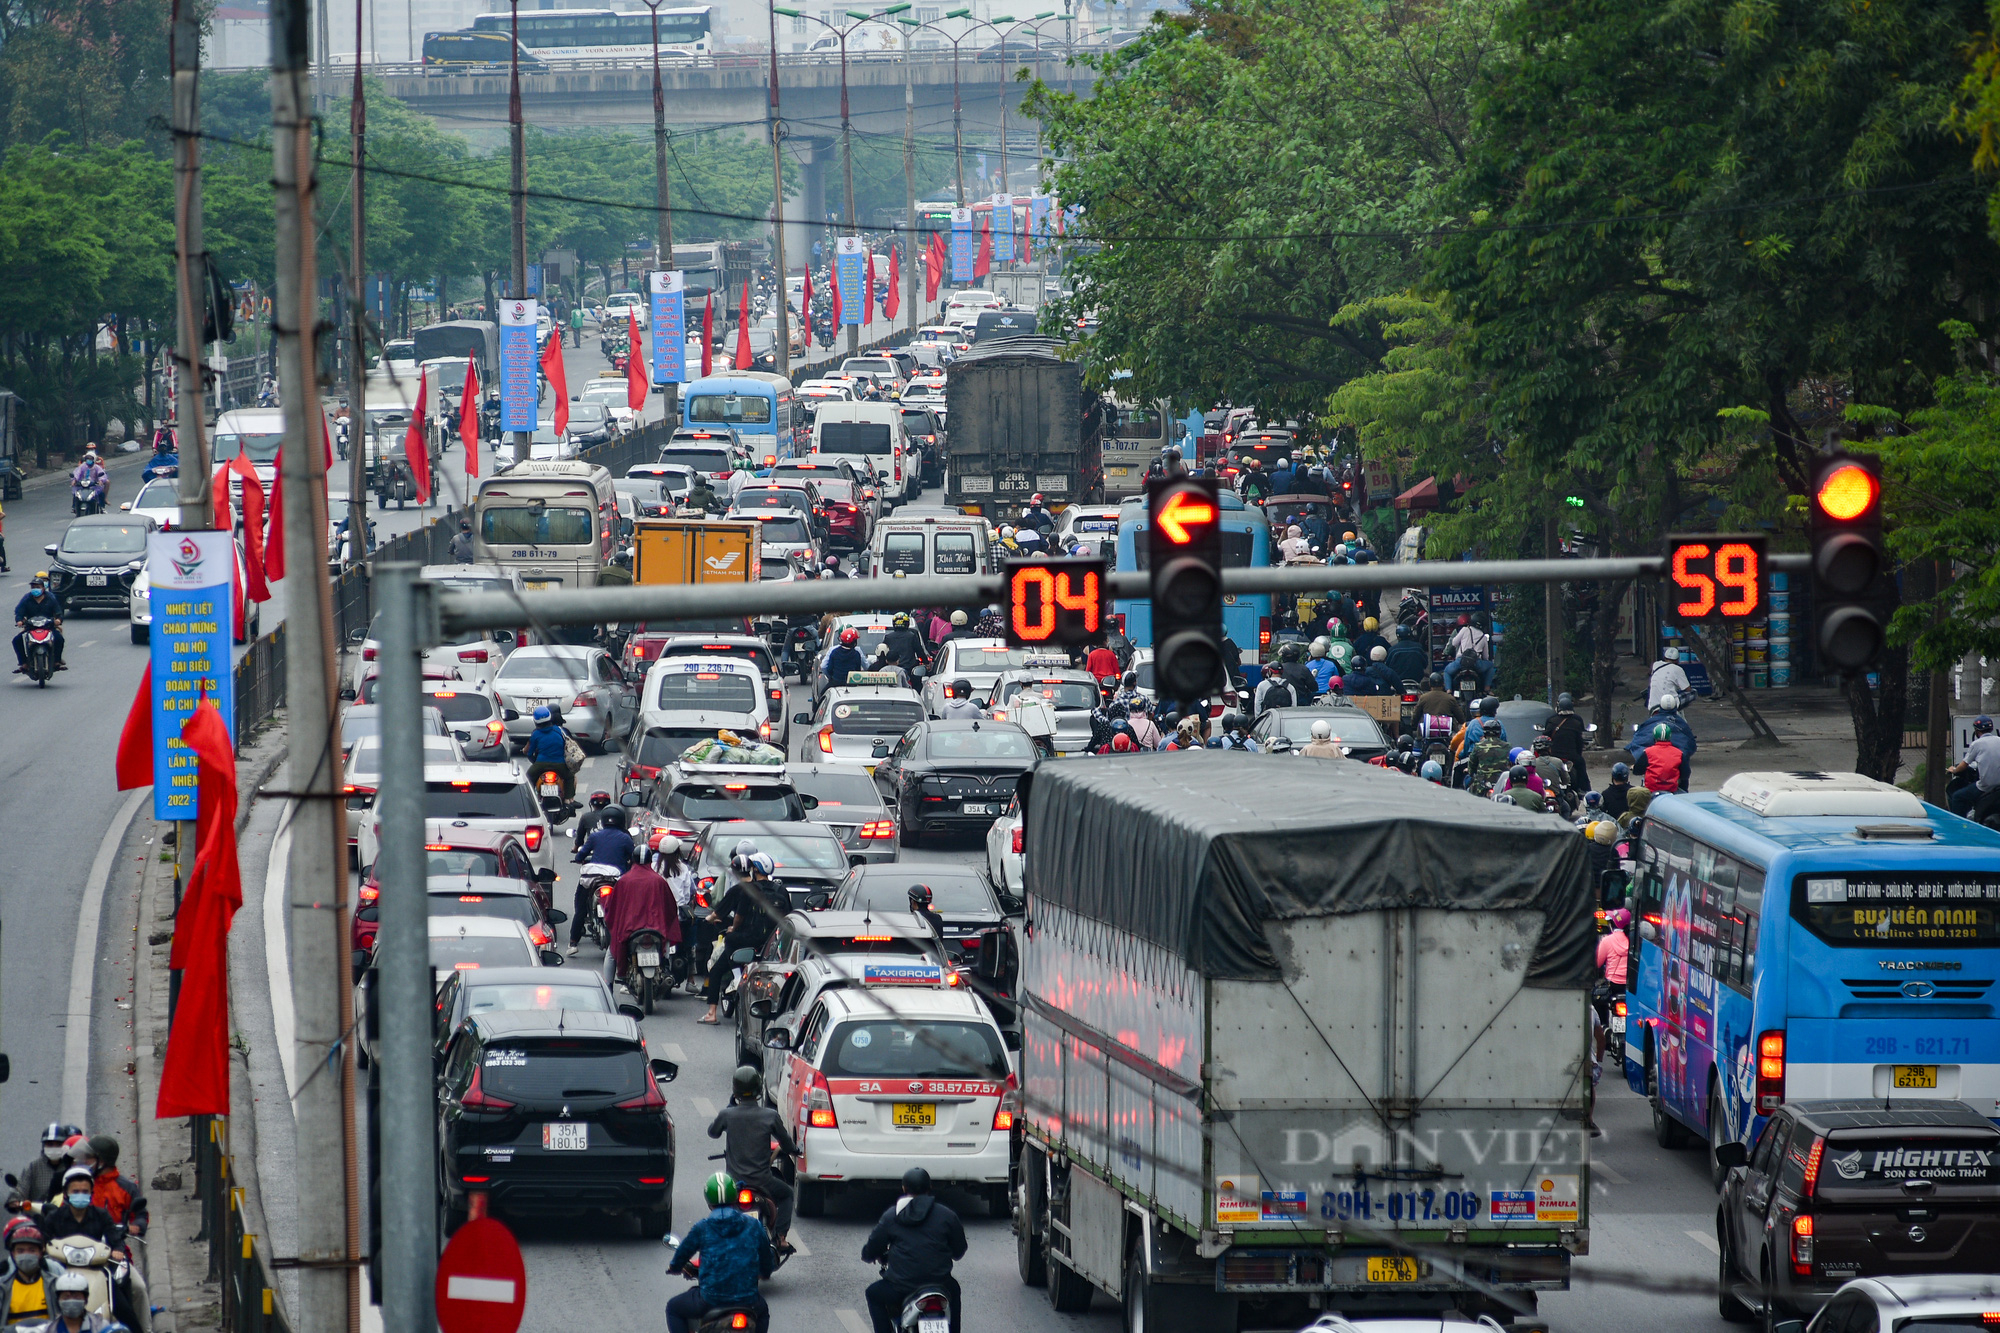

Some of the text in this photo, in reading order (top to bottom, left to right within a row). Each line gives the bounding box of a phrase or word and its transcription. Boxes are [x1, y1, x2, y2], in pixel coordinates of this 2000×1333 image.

[999, 481, 1030, 490] 001.33
[1672, 543, 1758, 617] 59
[1012, 567, 1099, 640] 04
[1432, 592, 1480, 606] EMAXX
[166, 601, 213, 616] NHIỆT LIỆT
[163, 621, 217, 634] CHÀO MỪNG
[173, 639, 207, 655] ĐẠI HỘI
[171, 656, 210, 674] ĐẠI BIỂU
[707, 663, 734, 672] 236.79
[165, 678, 191, 692] ĐOÀN
[163, 696, 175, 711] HỒ
[178, 697, 194, 711] CHÍ
[168, 753, 186, 768] LẦN
[168, 795, 189, 806] 2022
[1848, 884, 1857, 898] BX
[1857, 881, 1866, 898] MỸ
[1867, 881, 1882, 898] ĐÌNH
[1886, 881, 1901, 898] CHÙA
[1902, 881, 1914, 900] BỘC
[1918, 881, 1932, 898] GIÁP
[1932, 881, 1944, 898] BÁT
[1948, 881, 1964, 898] NƯỚC
[1964, 880, 1982, 898] NGẦM
[1854, 906, 1977, 925] BUS LIÊN NINH
[1864, 928, 1977, 938] Hotline 1900.1298
[874, 969, 940, 978] TAXIGROUP
[854, 1036, 869, 1044] 4750
[1865, 1037, 1898, 1055] 29B
[1915, 1037, 1970, 1055] 621.71
[1906, 1067, 1925, 1077] 29B
[859, 1082, 997, 1094] 3A 38.57.57.57
[1899, 1077, 1932, 1087] 621.71
[905, 1104, 923, 1114] 30E
[898, 1115, 931, 1124] 156.99
[558, 1124, 578, 1136] 35A
[551, 1138, 586, 1149] 180.15
[1908, 1170, 1918, 1178] &
[1919, 1167, 1956, 1178] CHỐNG
[1959, 1166, 1987, 1178] THẤM
[1320, 1192, 1478, 1221] 89H-017.06
[1539, 1200, 1576, 1208] RIMULA
[1820, 1262, 1862, 1270] NAVARA
[1372, 1270, 1412, 1281] 017.06
